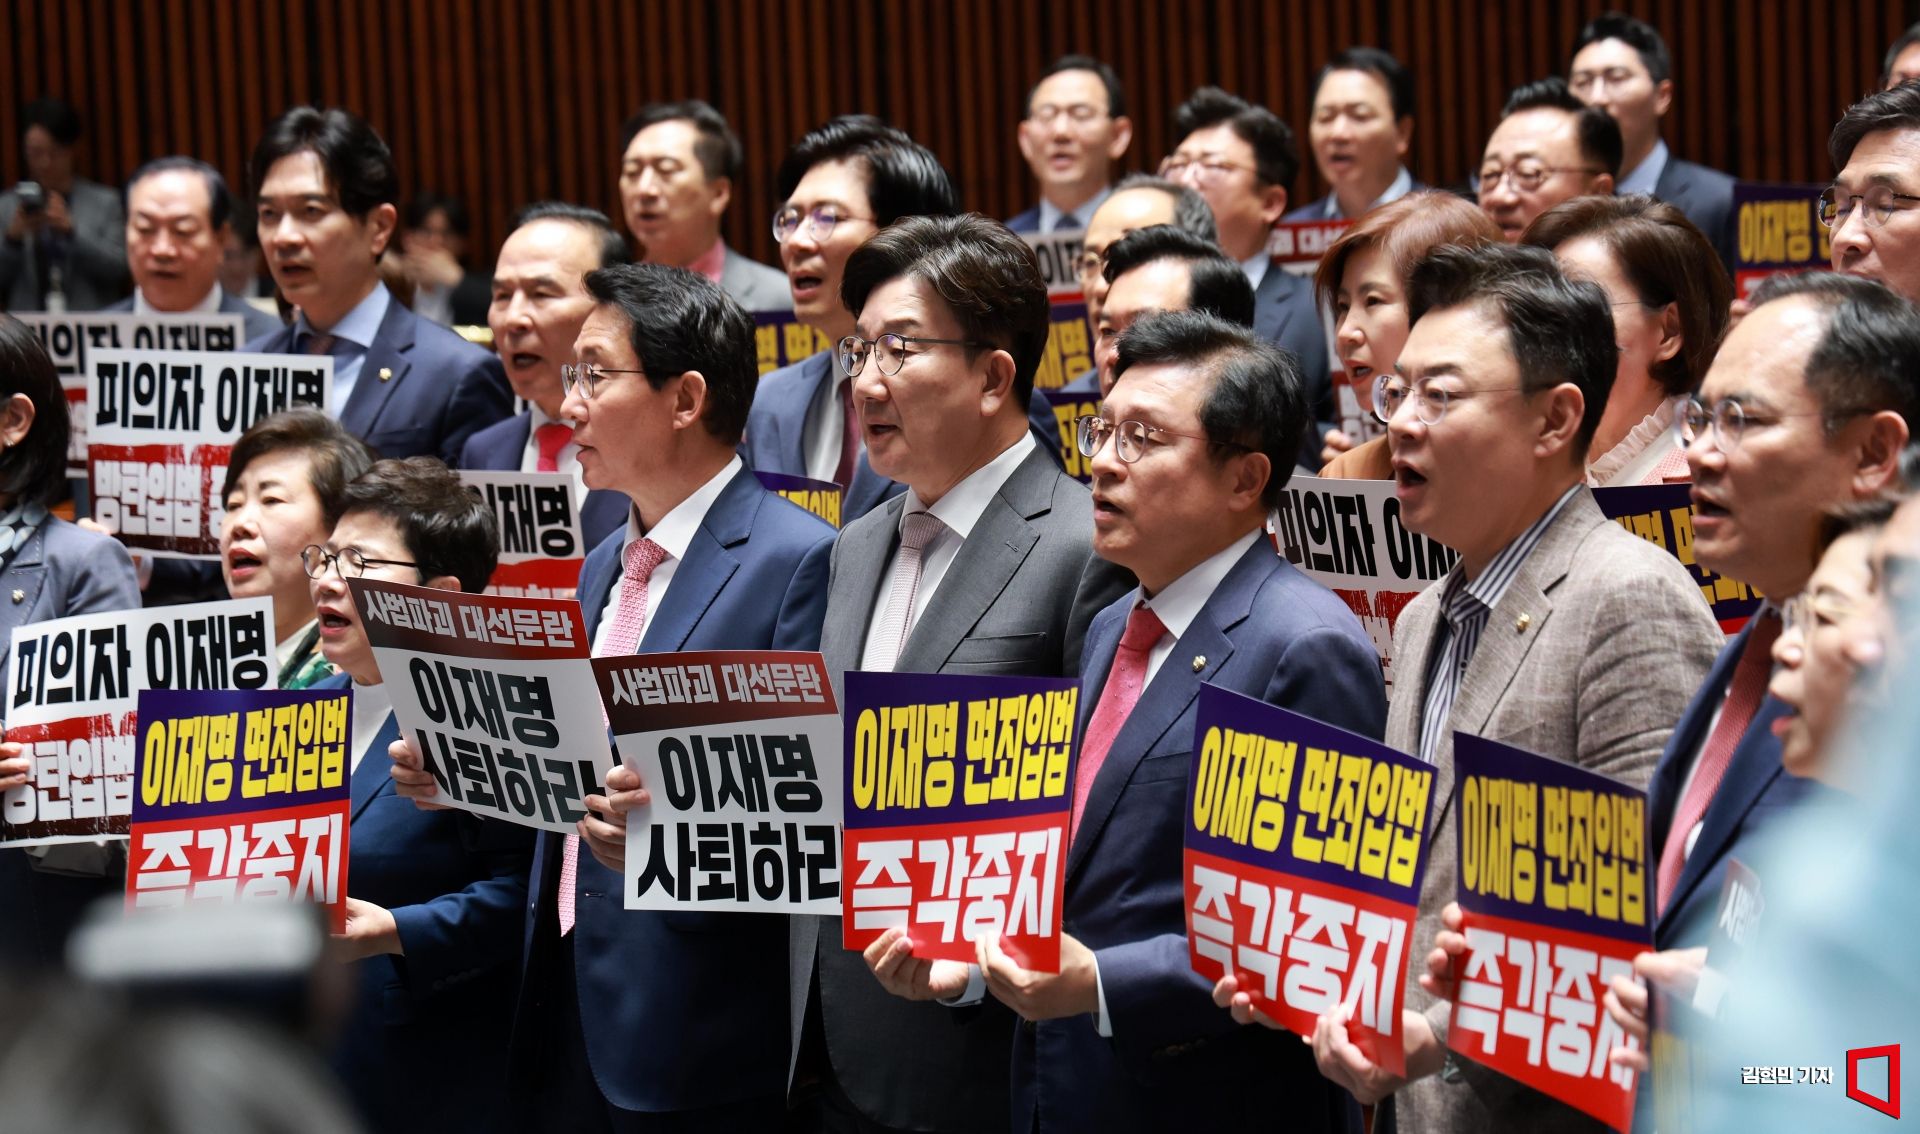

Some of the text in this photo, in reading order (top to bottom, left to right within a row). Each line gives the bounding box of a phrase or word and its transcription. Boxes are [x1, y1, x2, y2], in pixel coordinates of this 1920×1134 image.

[1738, 199, 1812, 264] 이재명
[96, 361, 204, 431] 피의자
[94, 460, 202, 538] 방탄입법
[466, 483, 575, 557] 재명
[1278, 488, 1378, 577] 피의자
[13, 610, 268, 710] 피의자 이재명
[365, 589, 575, 647] 사법파괴 대선문란
[408, 656, 560, 749] 이재명
[609, 663, 824, 706] 사법파괴 대선문란
[140, 695, 349, 807] 이재명 면죄입법
[414, 727, 606, 824] 사퇴하라
[657, 732, 824, 814] 이재명
[853, 687, 1078, 811] 이재명 면죄입법
[1193, 726, 1432, 888] 이재명 면죄입법
[1461, 774, 1537, 905] 이재명
[1542, 785, 1646, 926] 면죄입법
[852, 826, 1062, 943] 즉각중지
[1192, 863, 1408, 1037] 즉각중지
